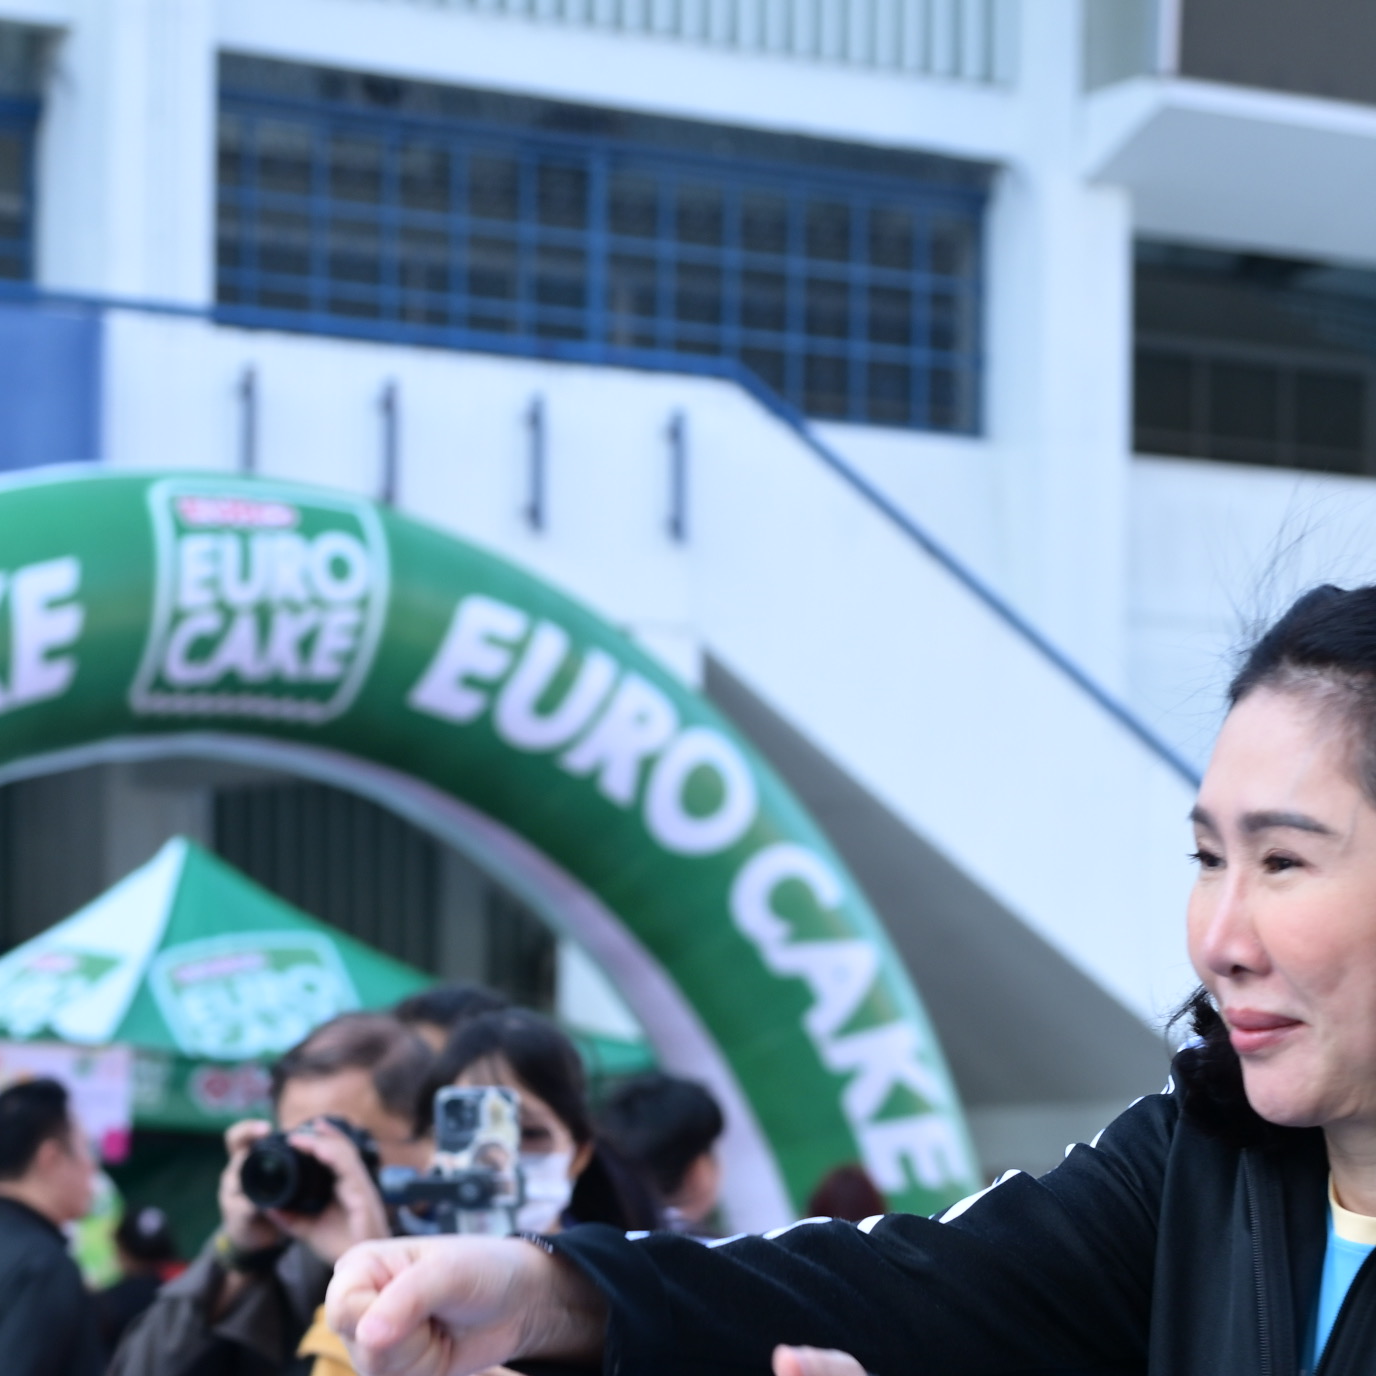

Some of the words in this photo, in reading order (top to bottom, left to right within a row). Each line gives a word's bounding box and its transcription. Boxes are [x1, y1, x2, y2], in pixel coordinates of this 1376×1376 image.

[177, 531, 368, 608] EURO
[165, 606, 362, 685] CAKE
[408, 592, 758, 855] EURO
[728, 843, 971, 1194] CAKE
